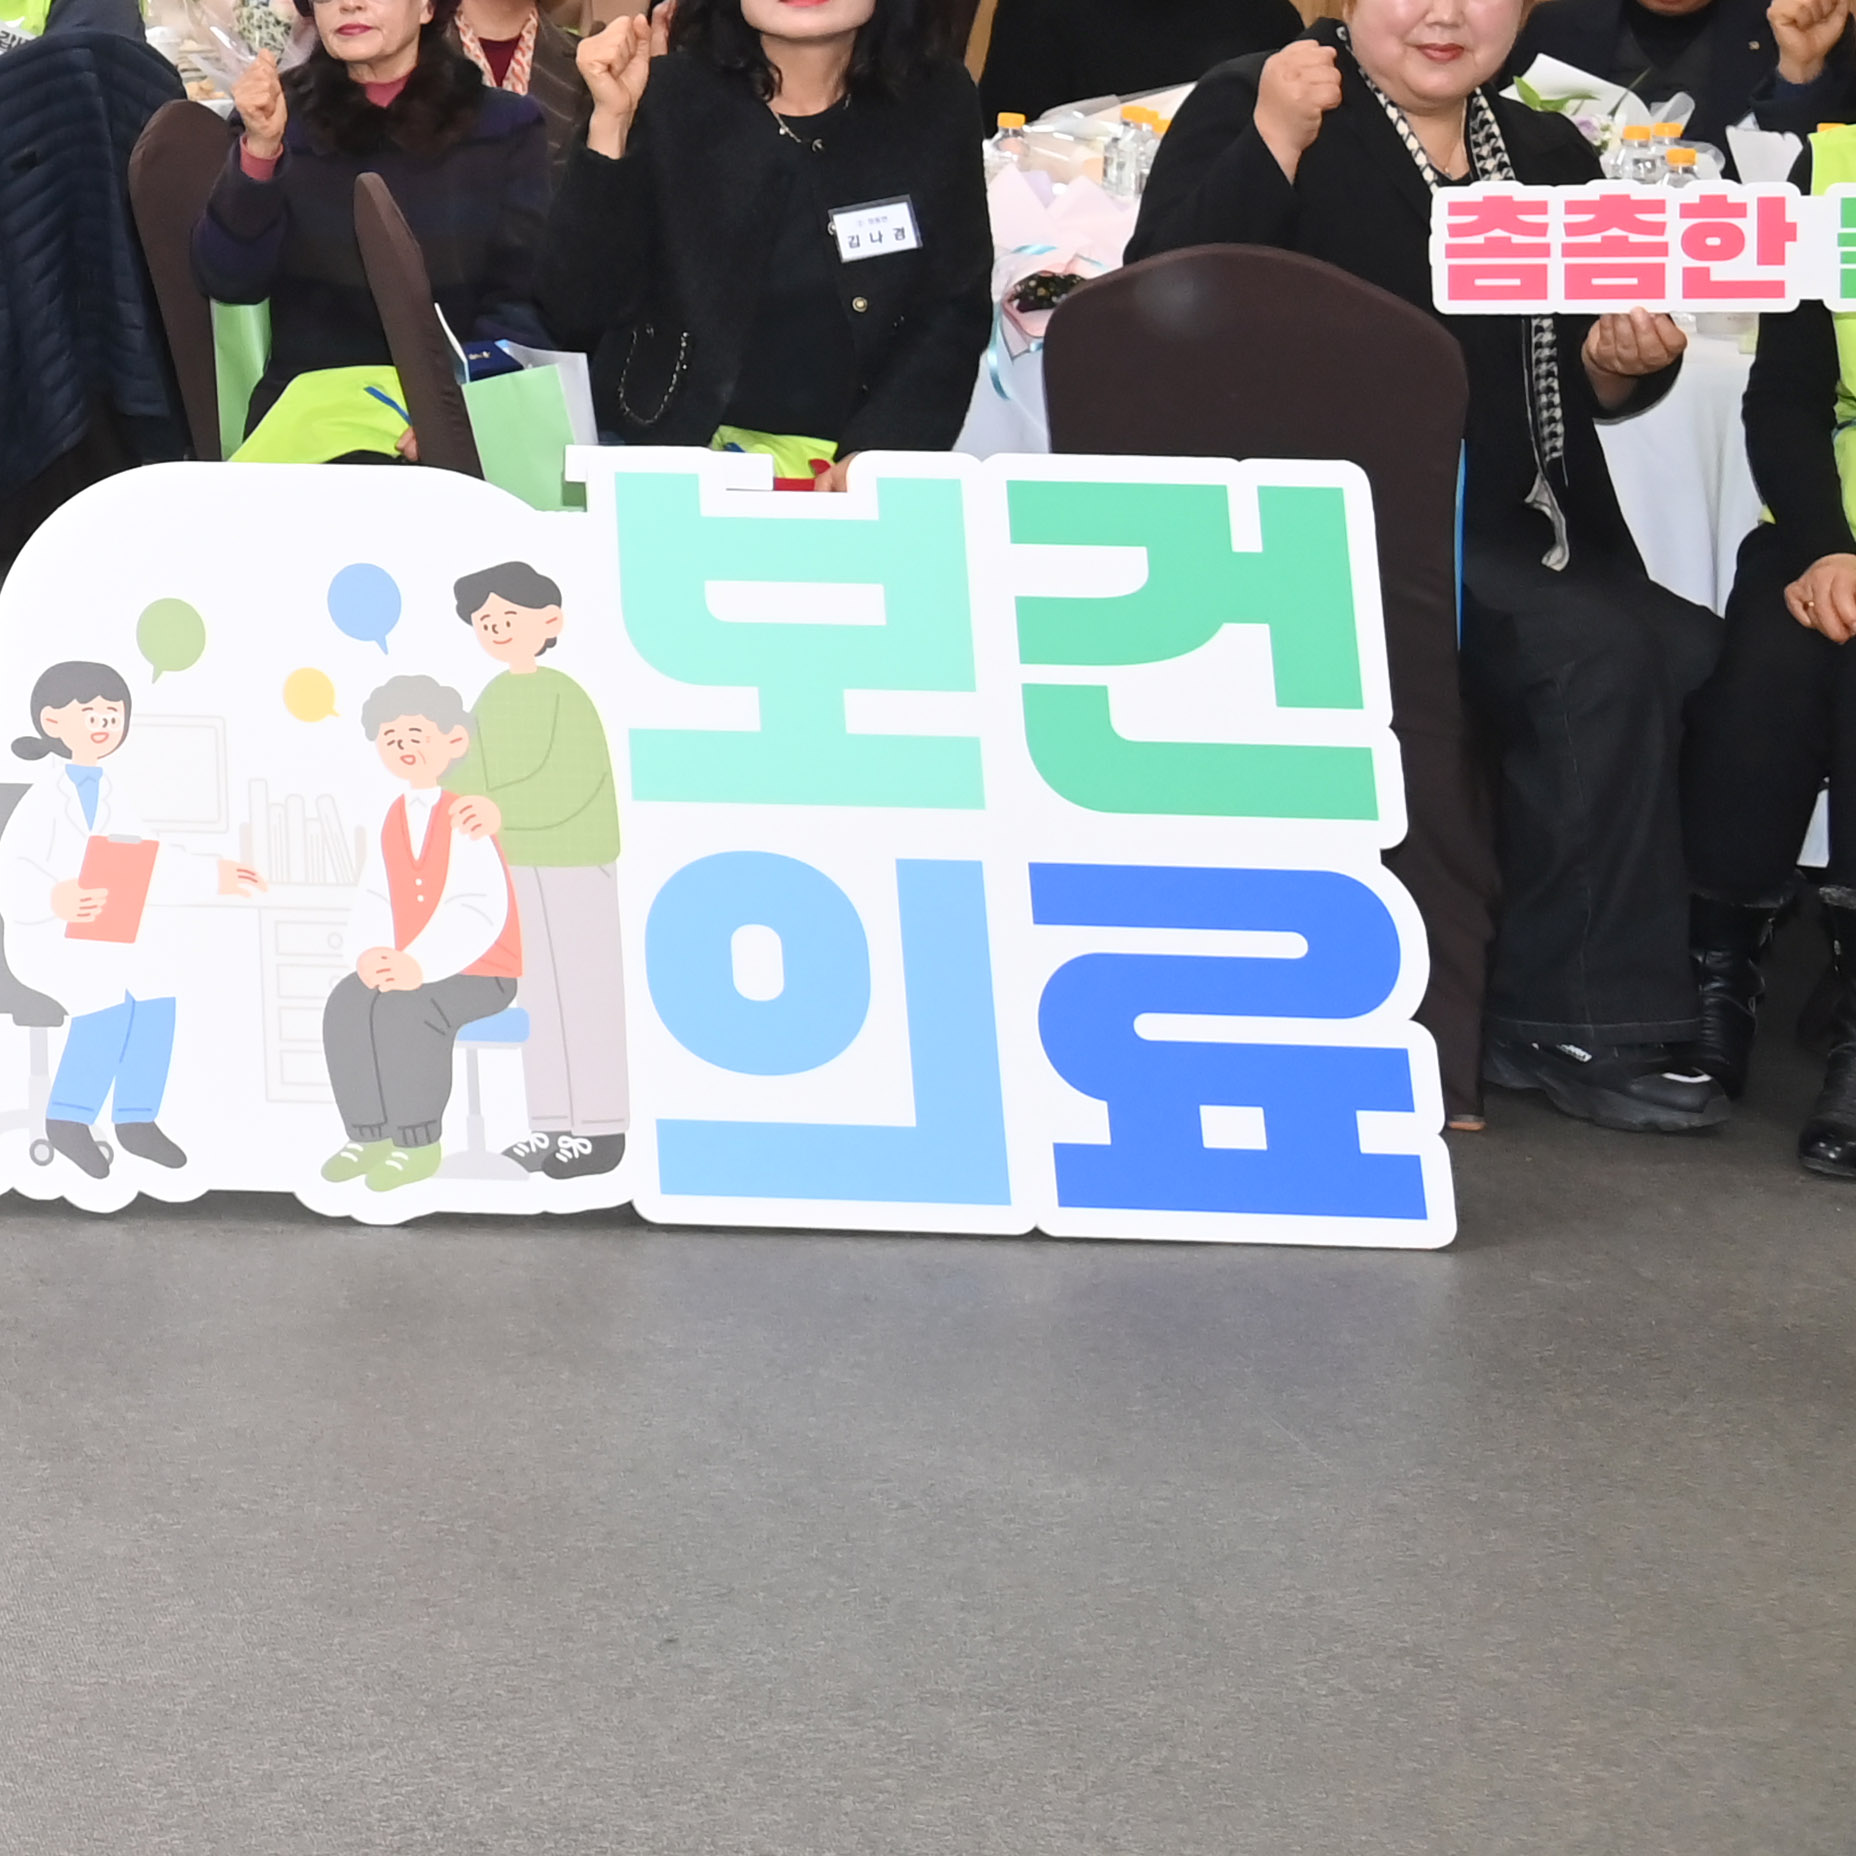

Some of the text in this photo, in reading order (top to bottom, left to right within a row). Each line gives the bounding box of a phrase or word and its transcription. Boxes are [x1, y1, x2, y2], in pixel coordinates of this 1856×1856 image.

[1444, 193, 1797, 301] 촘촘한
[614, 471, 1380, 821] 보건
[644, 850, 1428, 1221] 의료
